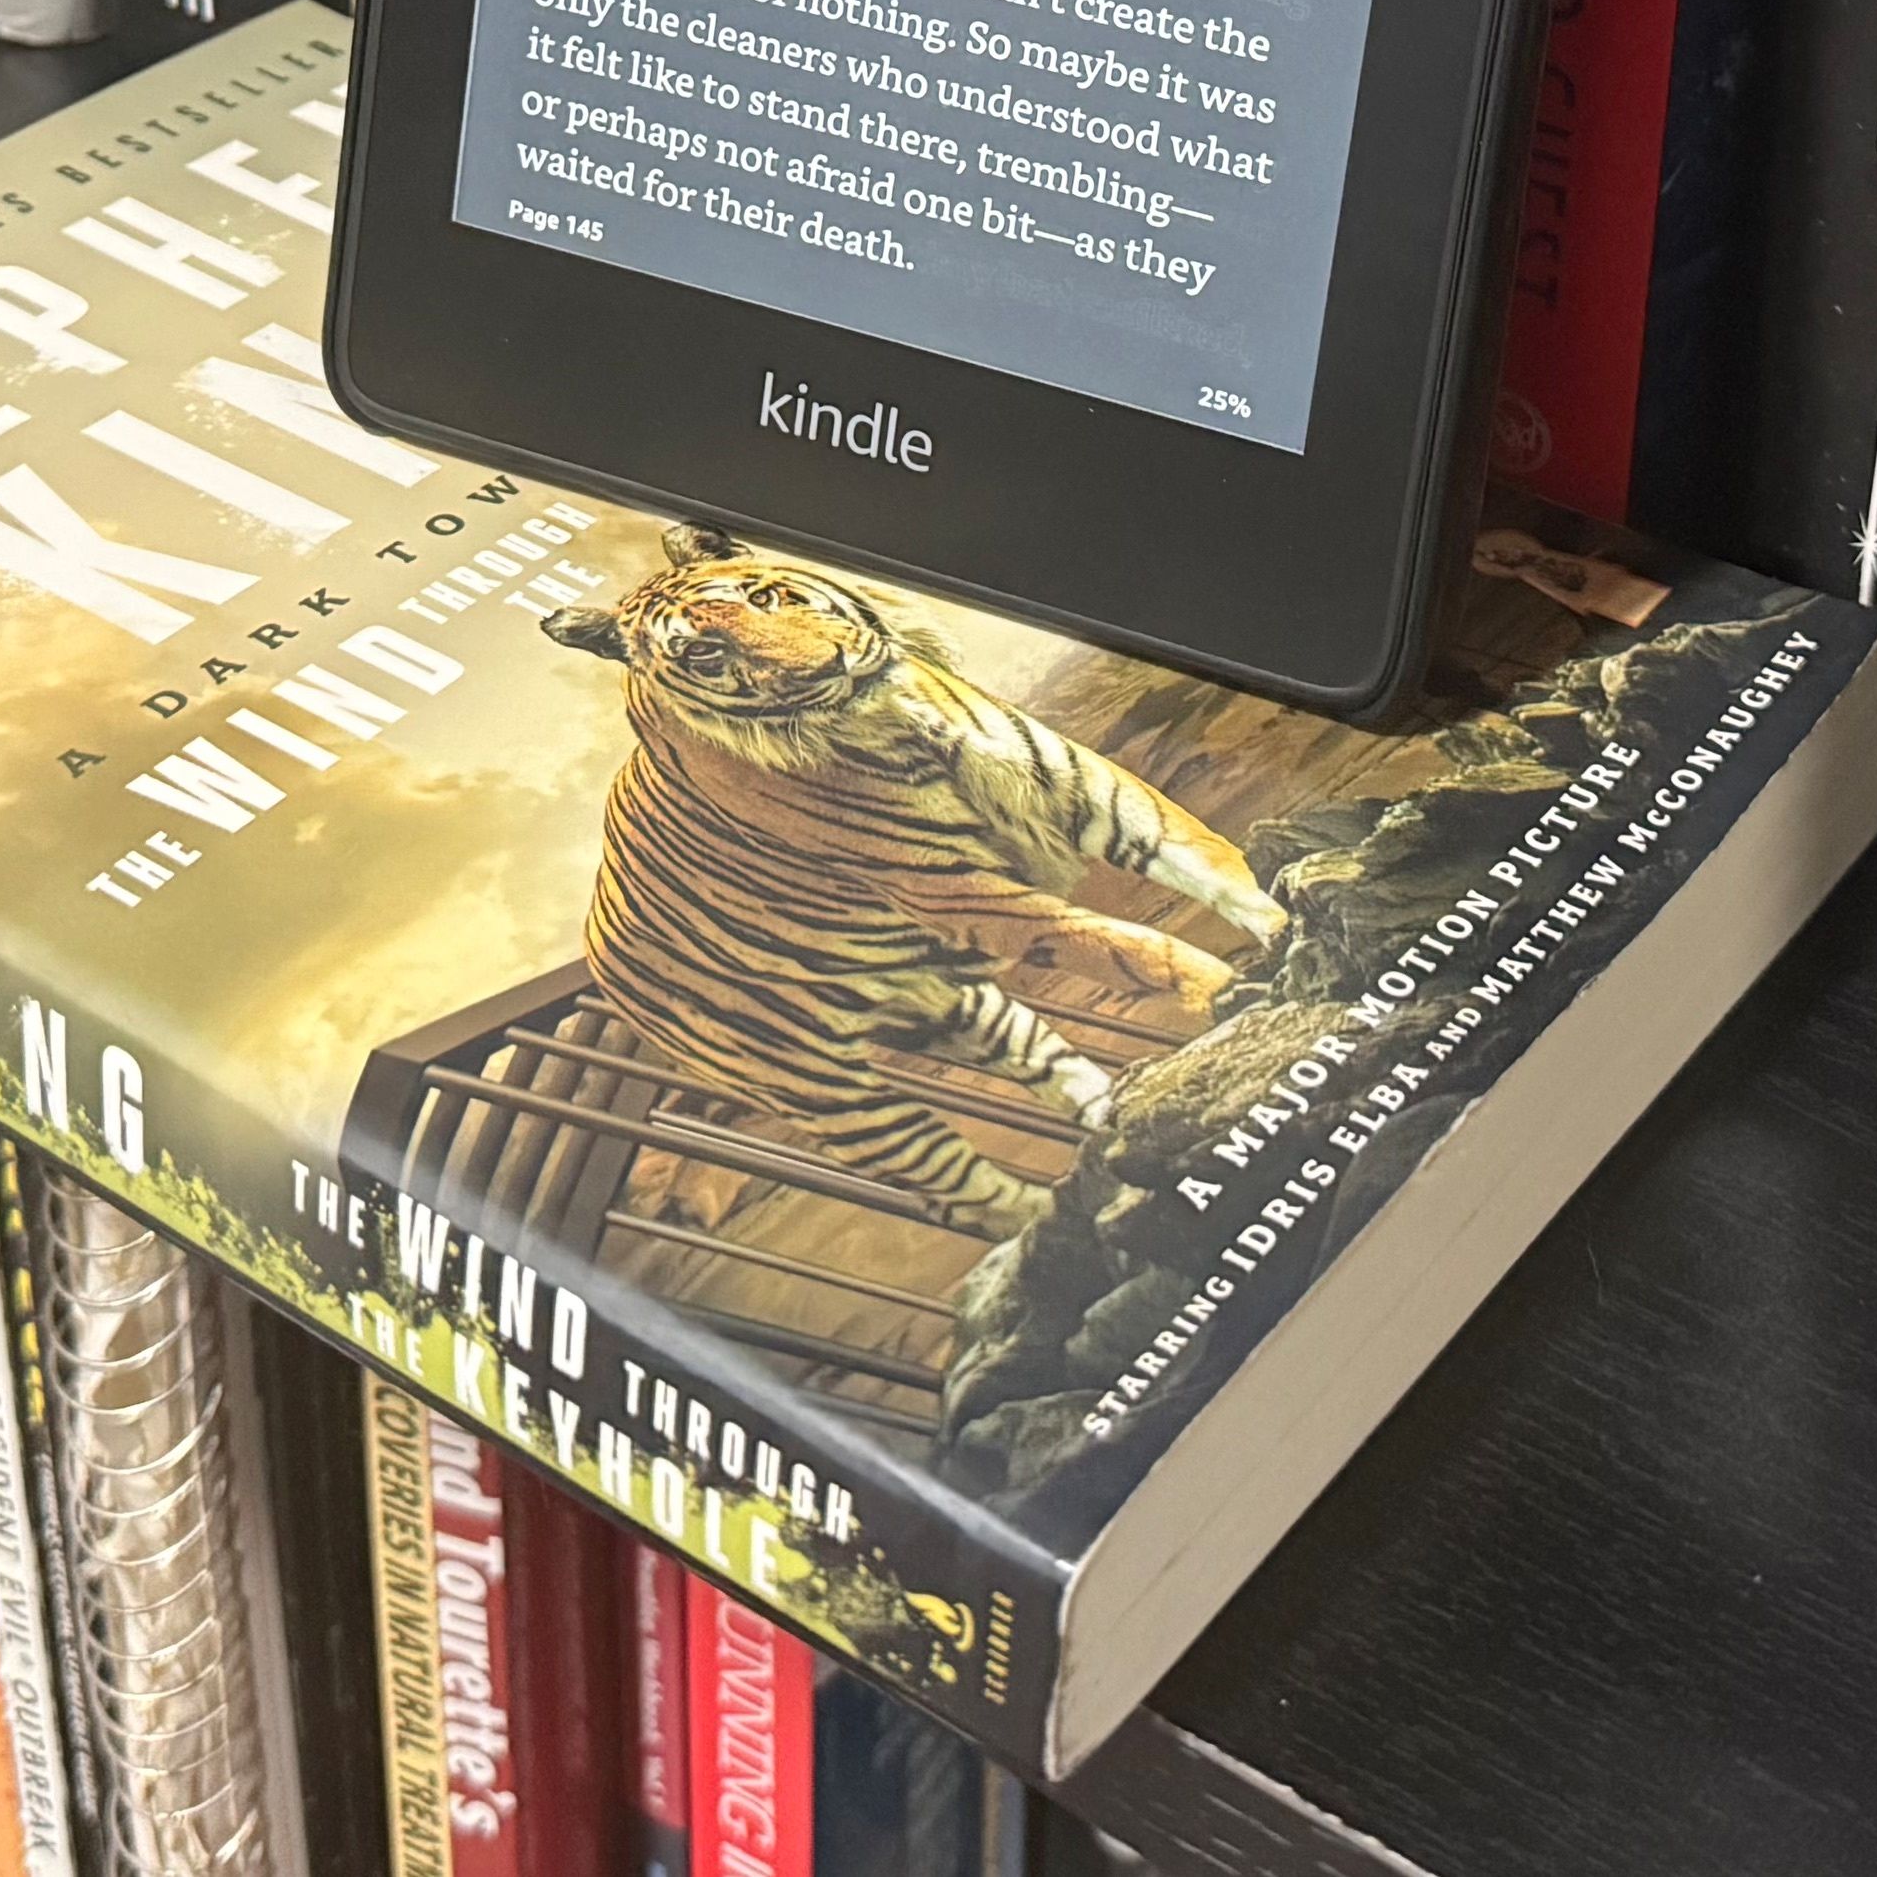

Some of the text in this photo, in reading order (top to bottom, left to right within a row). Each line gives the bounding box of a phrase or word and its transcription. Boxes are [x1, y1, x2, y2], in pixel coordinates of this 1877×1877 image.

[55, 38, 347, 185] BESTSELLER
[685, 11, 838, 76] cleaners
[845, 53, 928, 99] who
[935, 78, 1161, 157] understood
[1169, 133, 1274, 184] what
[507, 198, 604, 242] Page 145
[515, 141, 914, 271] waited for their death.
[760, 371, 933, 473] kindle
[1197, 385, 1252, 419] 25%
[503, 558, 608, 621] THE
[56, 747, 108, 778] A
[139, 586, 351, 720] DARK
[86, 501, 600, 909] THE WIND THROUGH
[1083, 630, 1820, 1439] STARRING IDRIS ELBA AND MATTHEW McCONAUGHEY
[1177, 738, 1642, 1214] A MAJOR MOTION PICTURE
[290, 1160, 855, 1544] THE WIND THROUGH
[348, 1290, 783, 1599] THE KEYHOLE
[384, 1557, 427, 1603] IN
[387, 1601, 436, 1755] NATURAL
[14, 1678, 60, 1857] OUTBREAK
